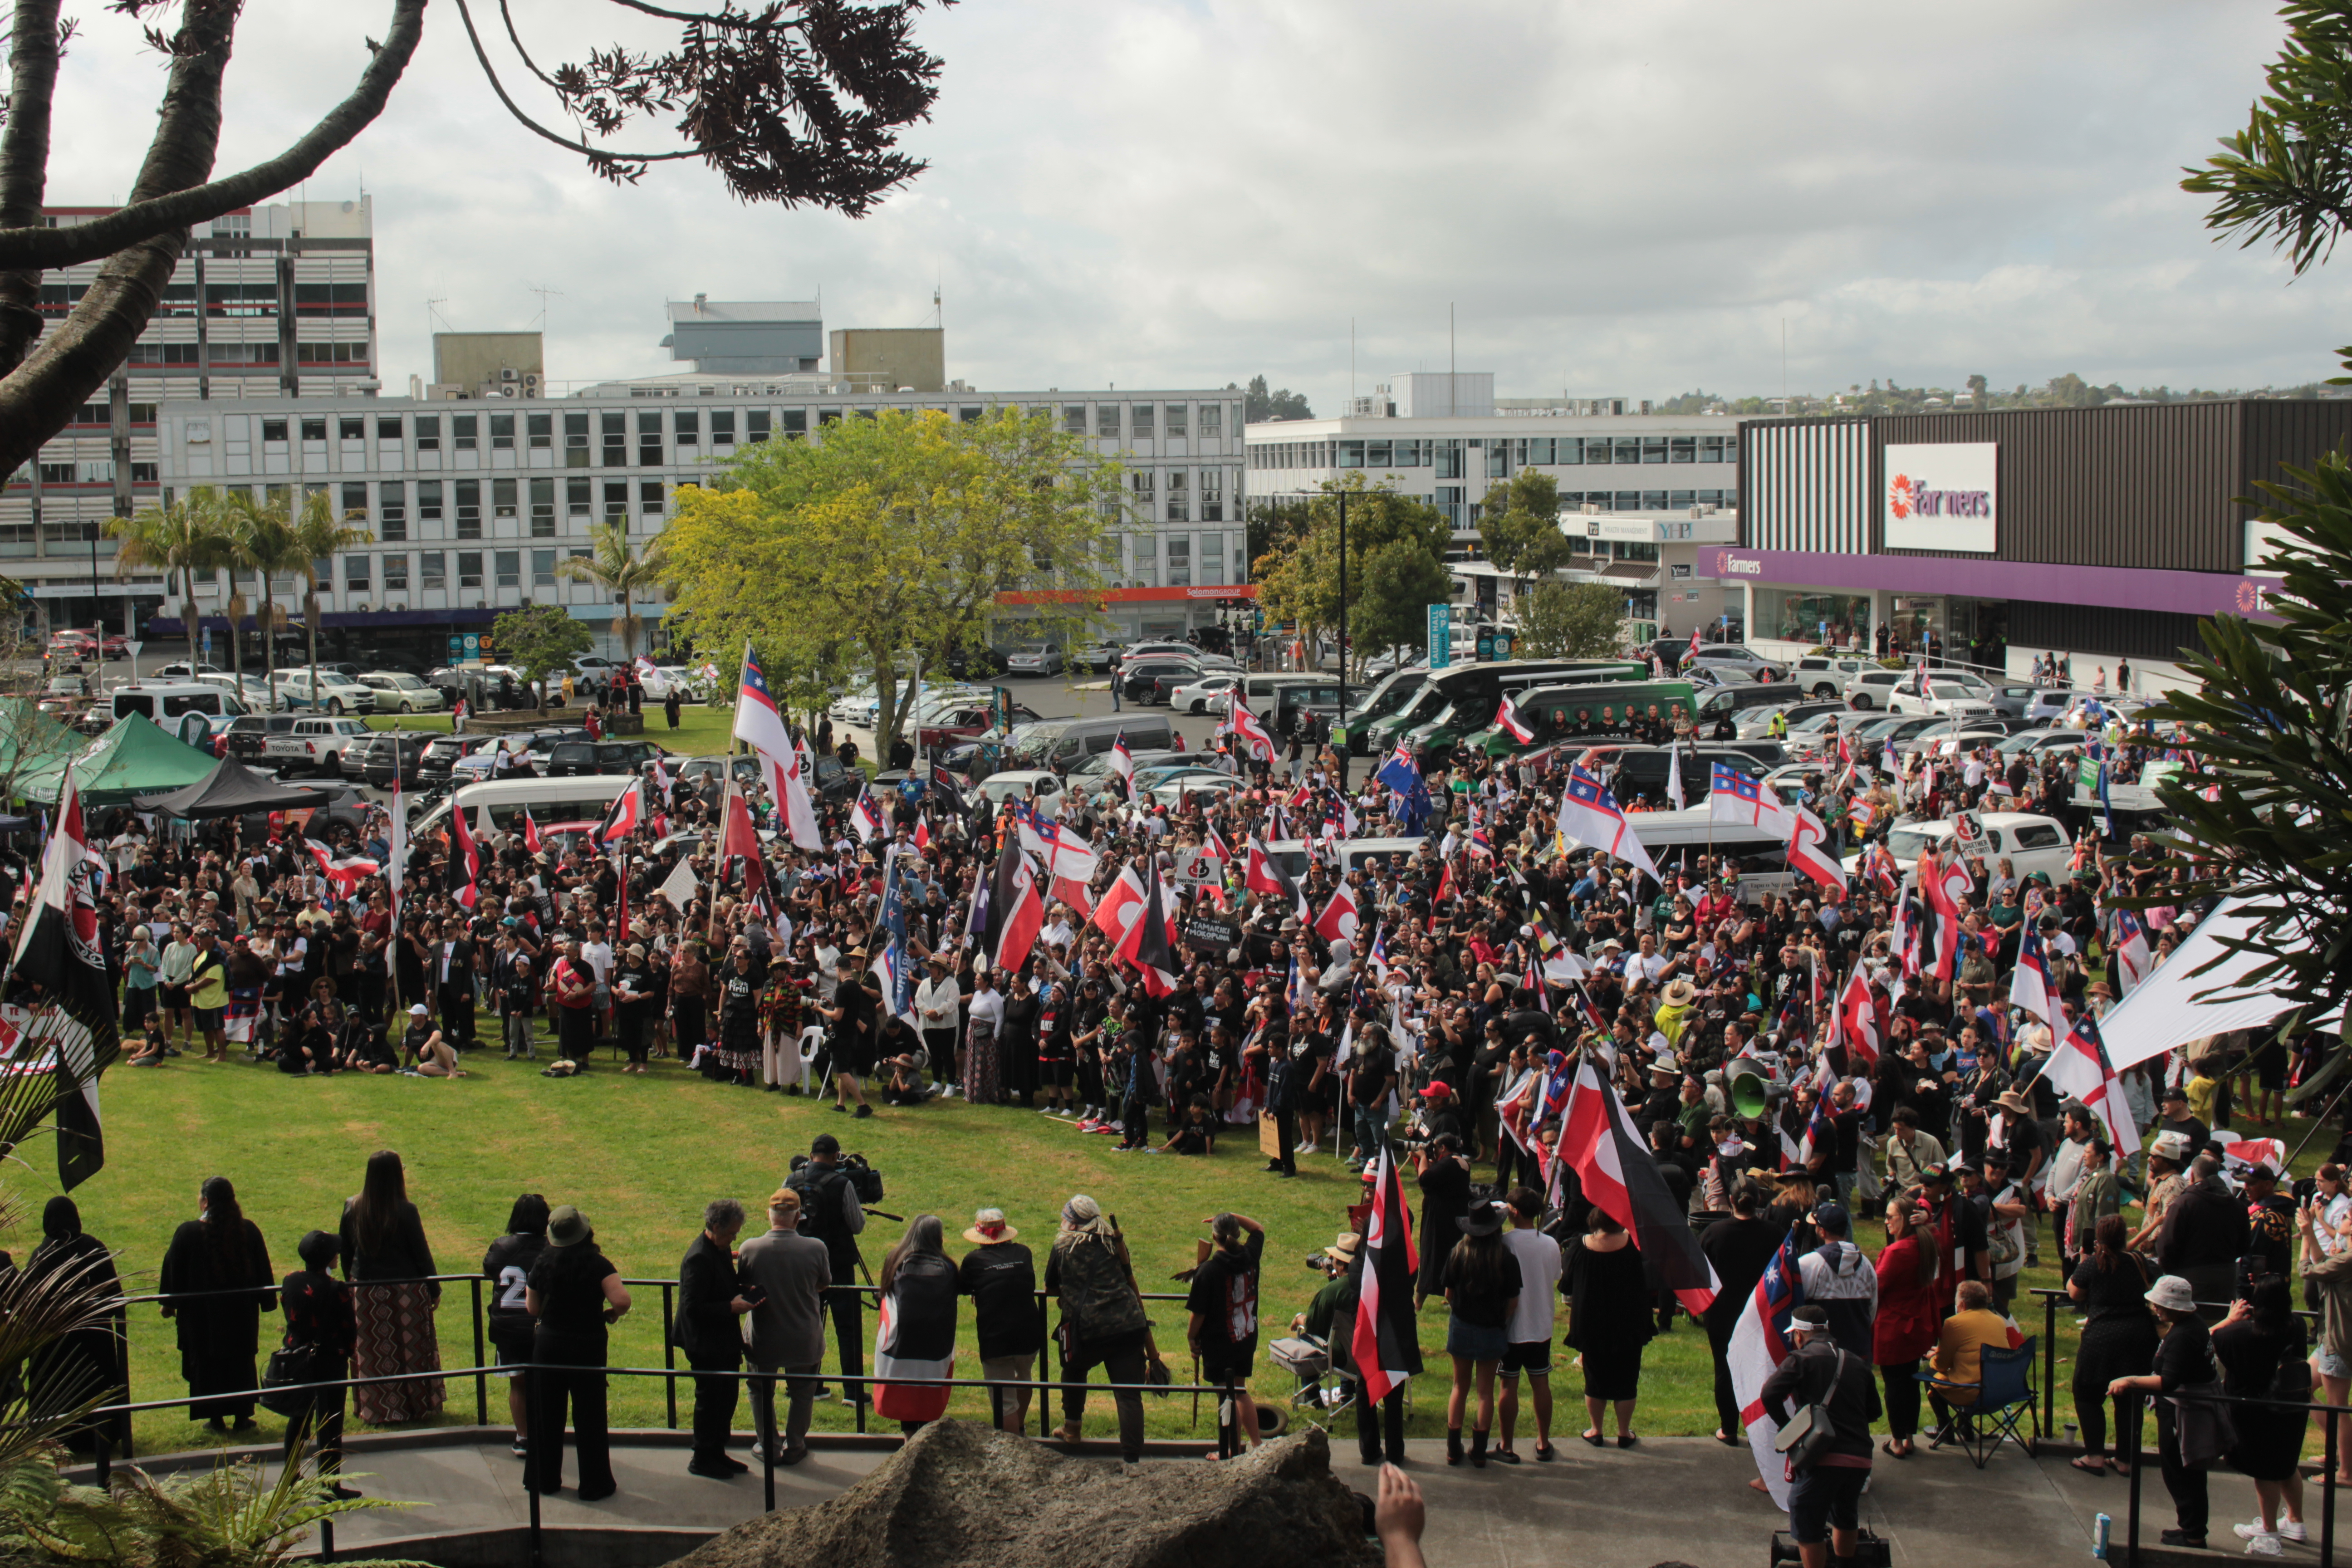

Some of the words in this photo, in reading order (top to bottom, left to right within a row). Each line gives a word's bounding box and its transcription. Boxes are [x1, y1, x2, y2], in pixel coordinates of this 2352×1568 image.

[1913, 480, 1988, 515] Farmers
[1671, 566, 1688, 576] Your
[1728, 554, 1760, 574] Farmers
[1962, 840, 1988, 849] TOGETHER
[1975, 847, 1990, 855] TIRITI
[889, 887, 901, 902] TE
[1192, 921, 1230, 935] TAMARIKI
[1189, 929, 1230, 942] MOKOPUNA
[500, 1266, 527, 1308] 2
